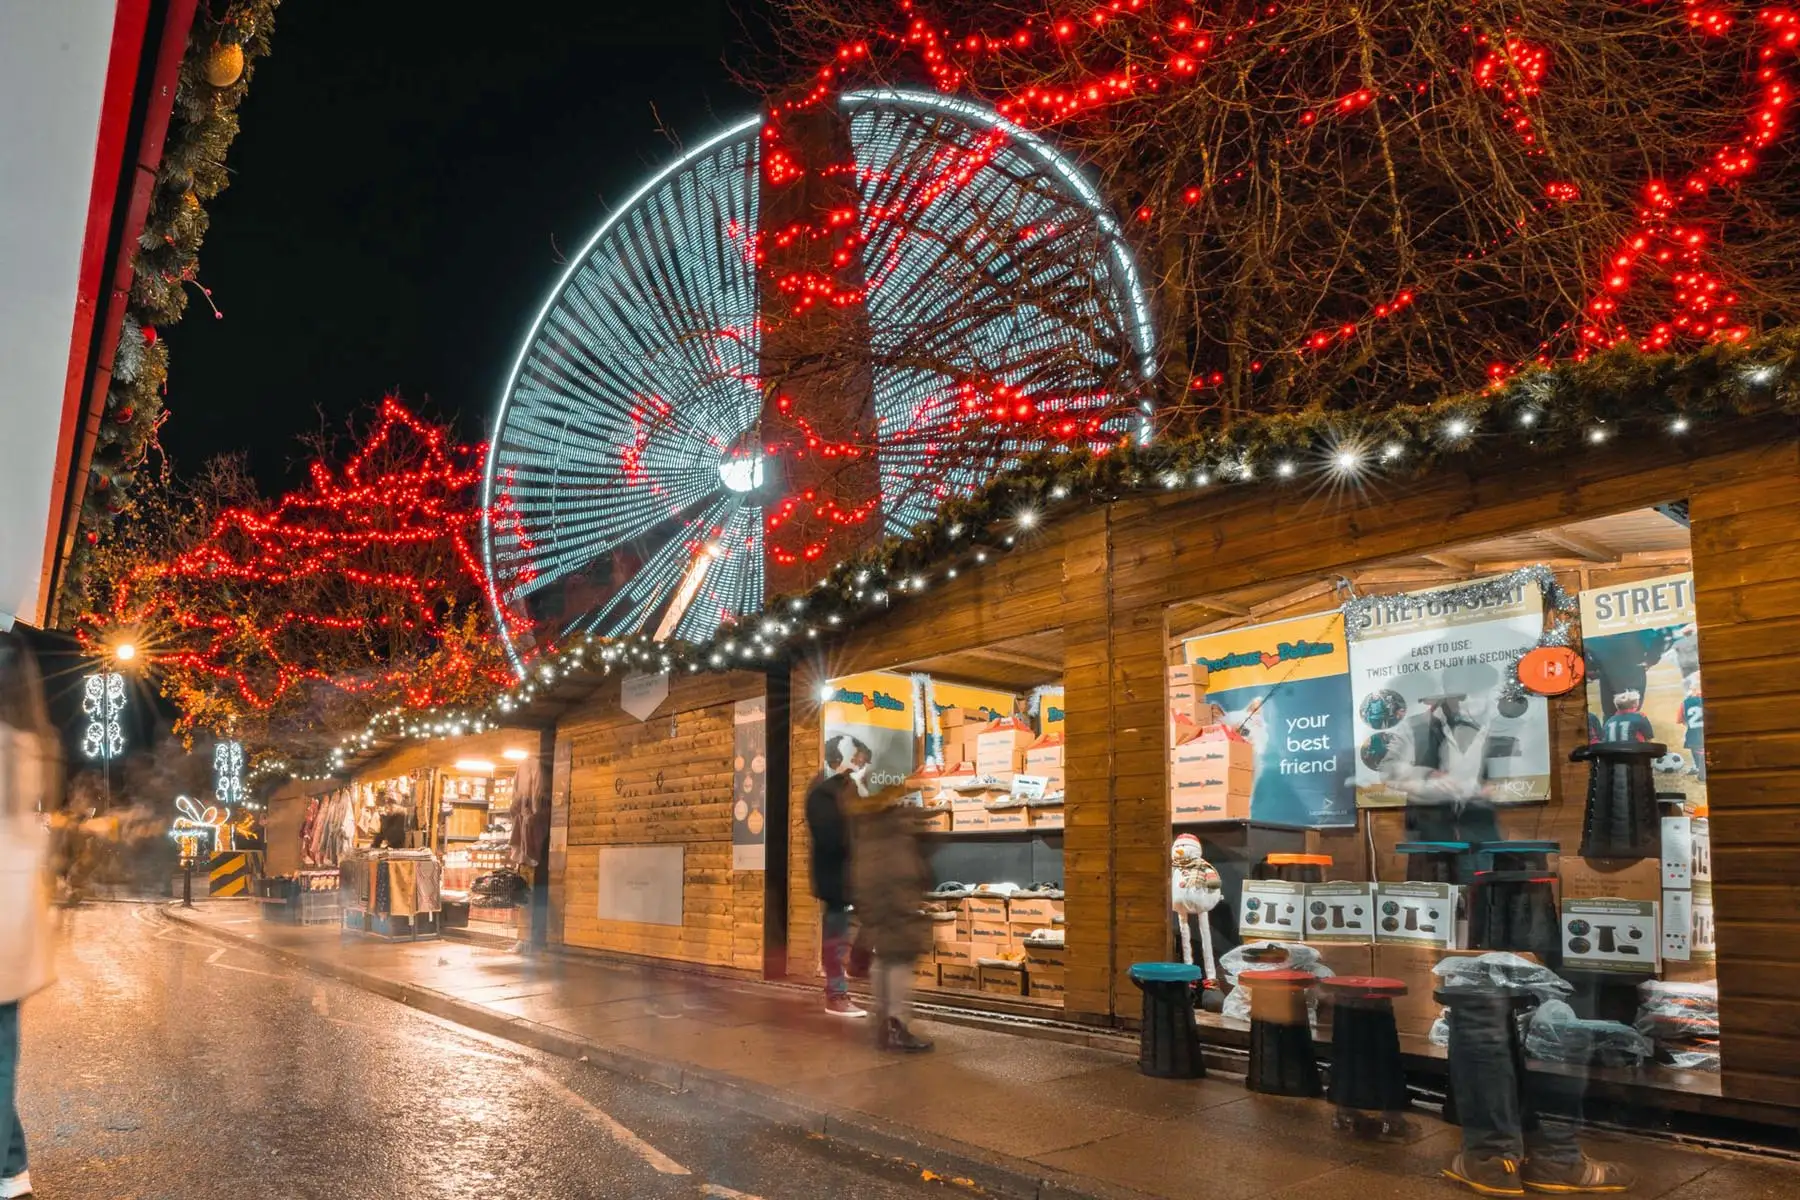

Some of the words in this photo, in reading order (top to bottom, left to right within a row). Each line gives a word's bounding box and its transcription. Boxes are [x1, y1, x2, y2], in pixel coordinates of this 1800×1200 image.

[1411, 644, 1434, 658] EASY
[1438, 642, 1449, 653] TO
[1451, 639, 1473, 652] USE:
[1397, 661, 1420, 674] LOCK
[1422, 660, 1431, 671] &
[1434, 656, 1465, 670] ENJOY
[1467, 653, 1477, 665] IN
[1286, 714, 1330, 734] your
[1287, 734, 1330, 752] best
[1279, 755, 1336, 775] friend
